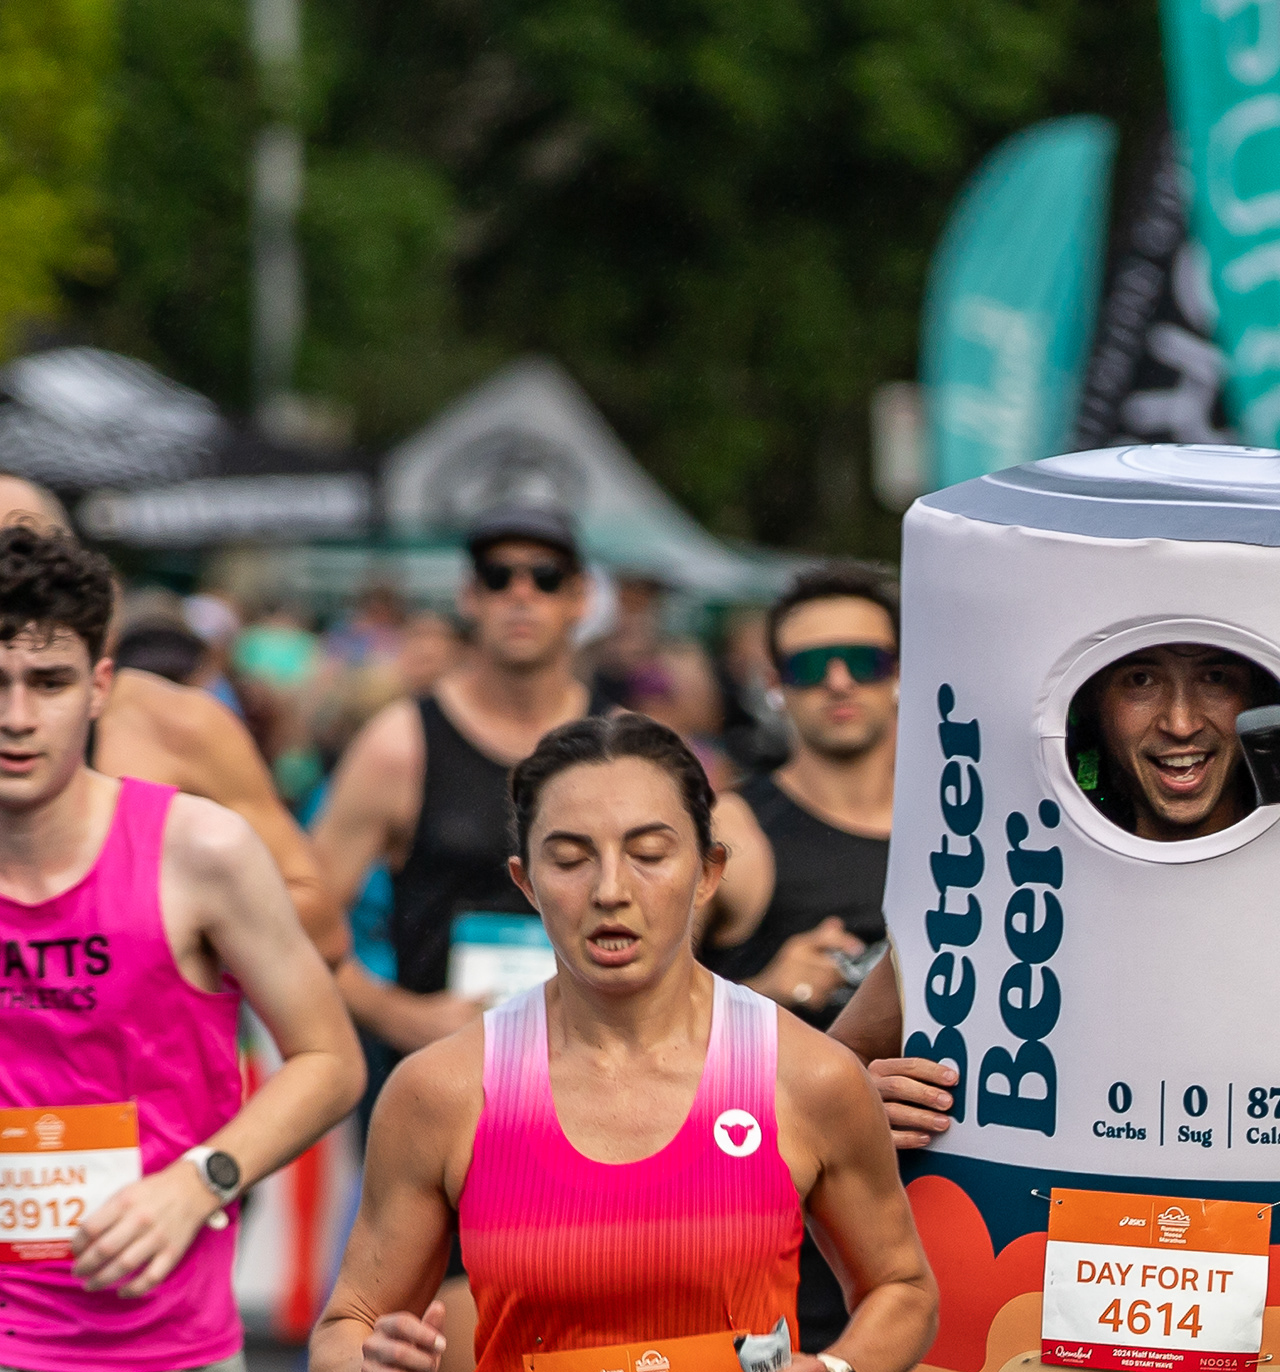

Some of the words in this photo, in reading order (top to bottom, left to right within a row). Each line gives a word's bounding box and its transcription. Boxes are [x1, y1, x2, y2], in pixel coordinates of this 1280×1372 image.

[977, 799, 1064, 1138] Beer.
[1108, 1081, 1133, 1115] 0
[1183, 1085, 1208, 1118] 0
[1093, 1121, 1147, 1142] Carbs
[1177, 1123, 1213, 1148] Sug
[1076, 1259, 1134, 1286] DAY
[1140, 1264, 1199, 1292] FOR
[1207, 1269, 1234, 1294] IT
[1098, 1298, 1203, 1339] 4614
[1112, 1348, 1131, 1358] 2024
[1132, 1350, 1148, 1360] Half
[1148, 1351, 1184, 1362] Marathon
[1199, 1358, 1238, 1368] NOOSA
